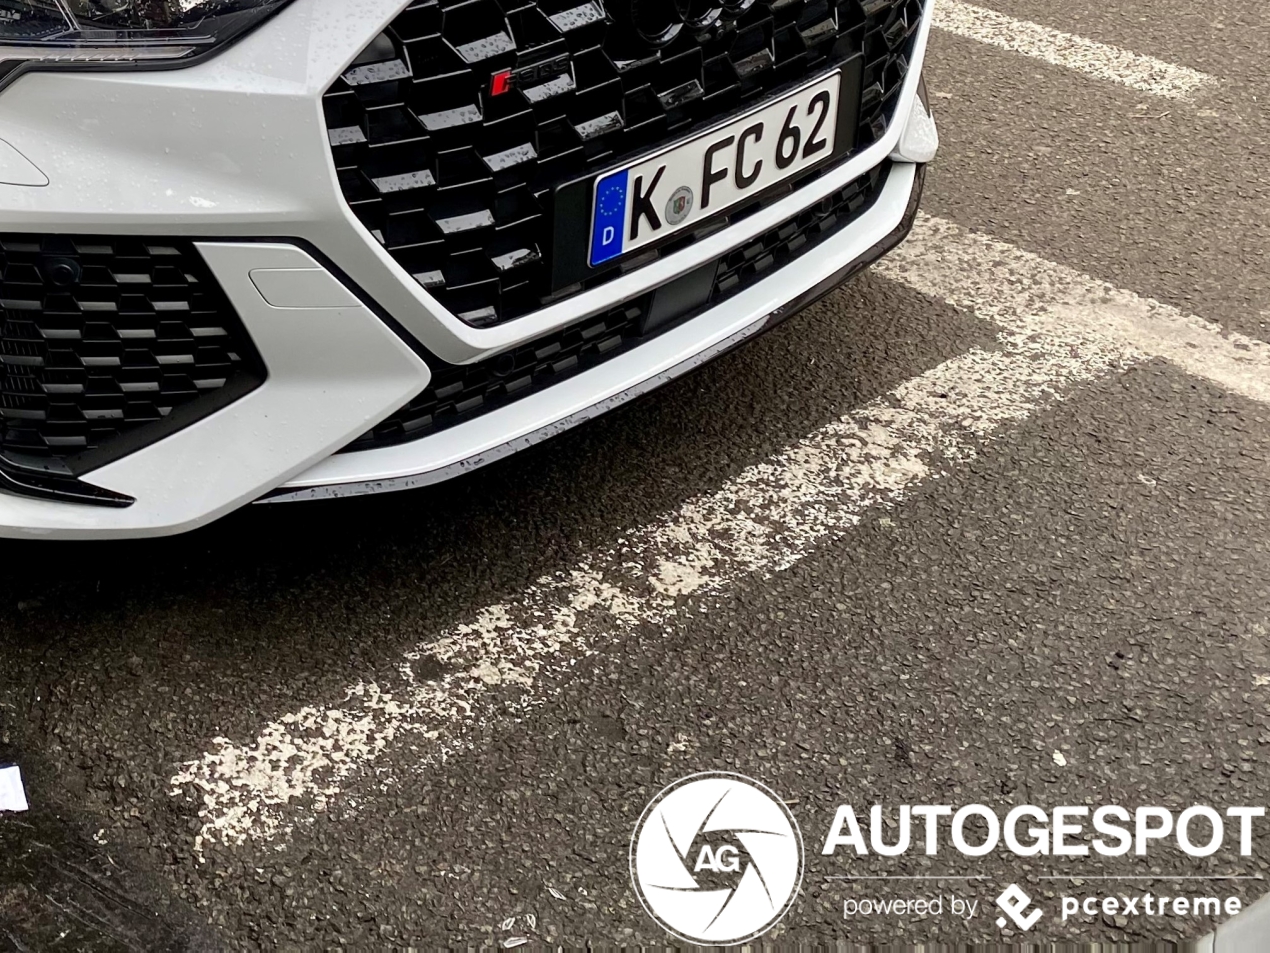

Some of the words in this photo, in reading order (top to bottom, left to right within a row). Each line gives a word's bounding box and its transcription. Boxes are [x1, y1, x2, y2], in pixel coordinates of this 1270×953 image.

[629, 164, 667, 241] K
[700, 121, 765, 210] FC
[775, 90, 831, 170] 62
[602, 226, 615, 246] D
